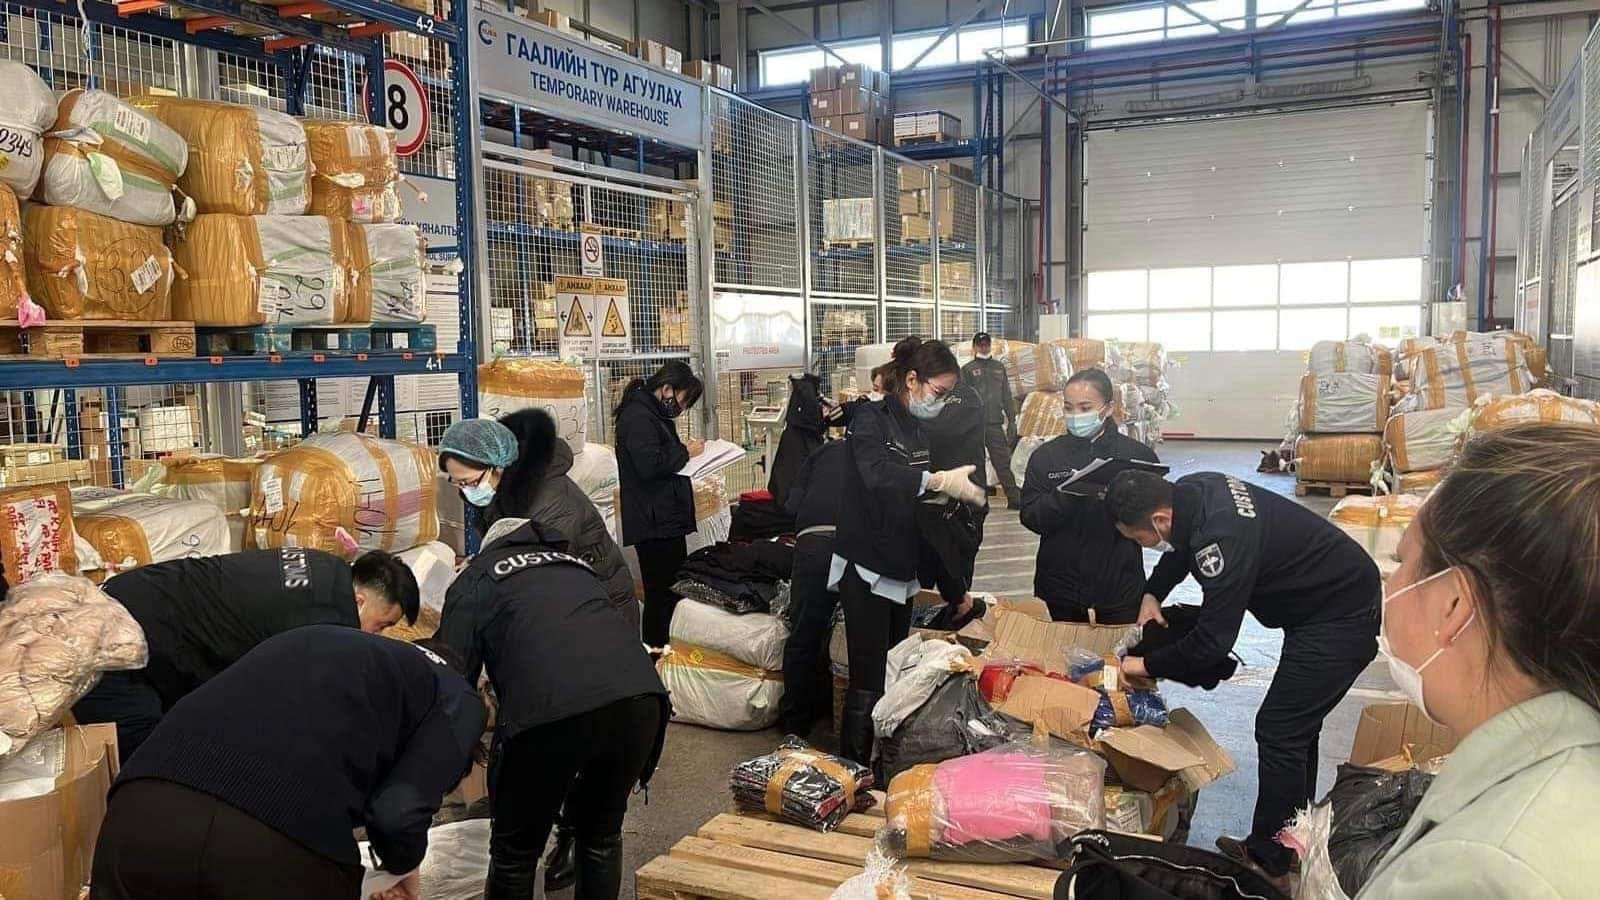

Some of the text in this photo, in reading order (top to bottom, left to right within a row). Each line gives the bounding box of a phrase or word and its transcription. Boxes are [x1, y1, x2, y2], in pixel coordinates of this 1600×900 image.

[416, 15, 434, 34] 4-2
[506, 32, 587, 79] ГААЛИЙН
[623, 72, 683, 109] АГУУЛАХ
[388, 84, 409, 130] 8
[530, 71, 669, 127] TEMPORARY WAREHOUSE
[425, 356, 442, 371] 4-1
